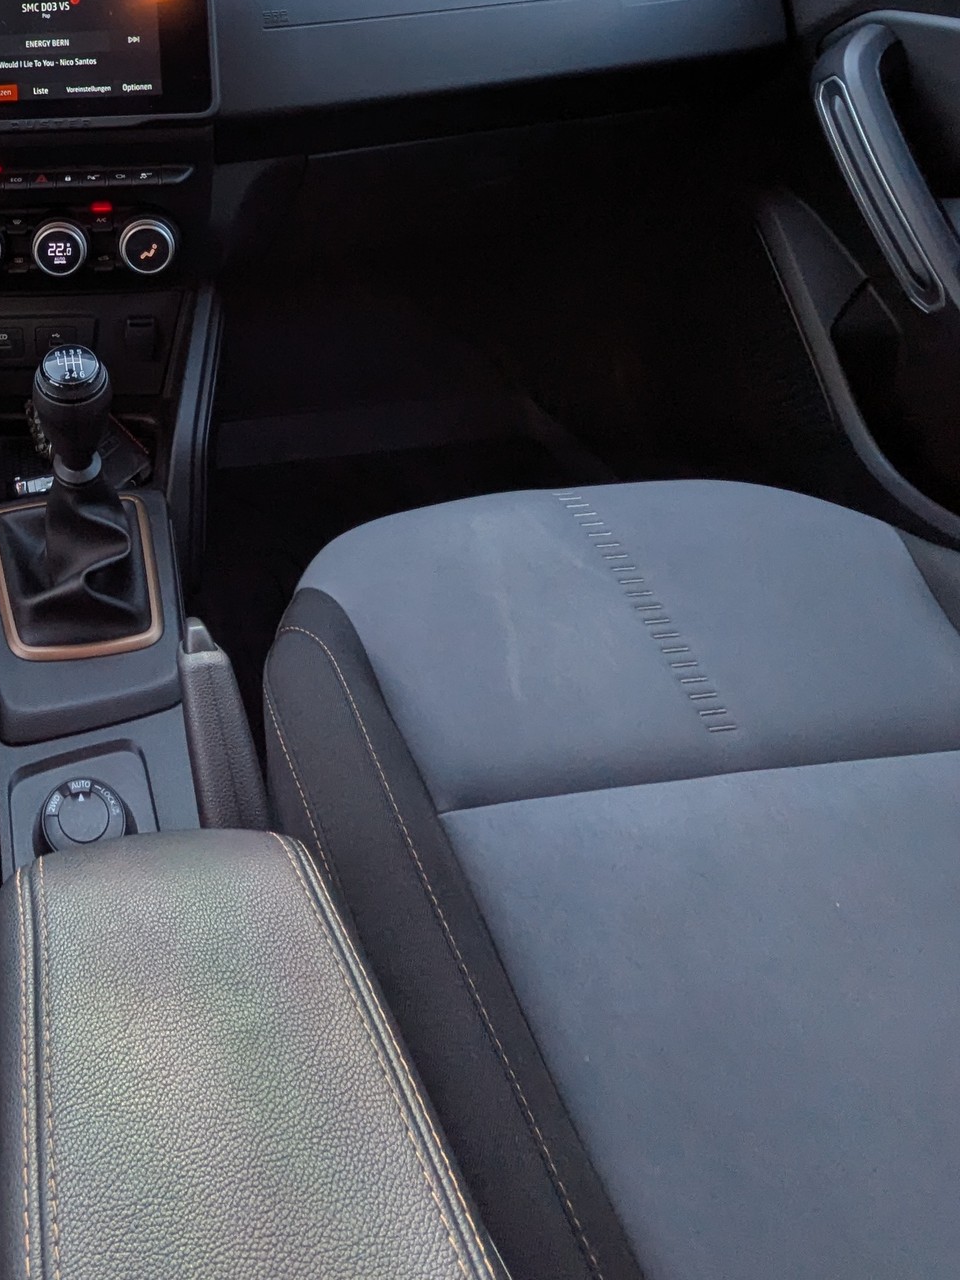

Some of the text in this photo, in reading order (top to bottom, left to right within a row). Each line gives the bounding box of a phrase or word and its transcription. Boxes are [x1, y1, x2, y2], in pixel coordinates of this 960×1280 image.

[21, 2, 40, 13] SMC
[59, 1, 70, 11] VS
[25, 39, 70, 48] ENERGY BERN
[23, 60, 33, 68] Lie
[42, 59, 54, 67] You
[74, 58, 97, 66] Santos
[33, 87, 49, 95] Liste
[66, 85, 112, 94] Voreinstellungen
[122, 83, 153, 92] Optionen
[64, 371, 71, 379] 2
[71, 371, 78, 379] 4
[71, 780, 91, 789] AUTO
[47, 793, 61, 813] 2WD
